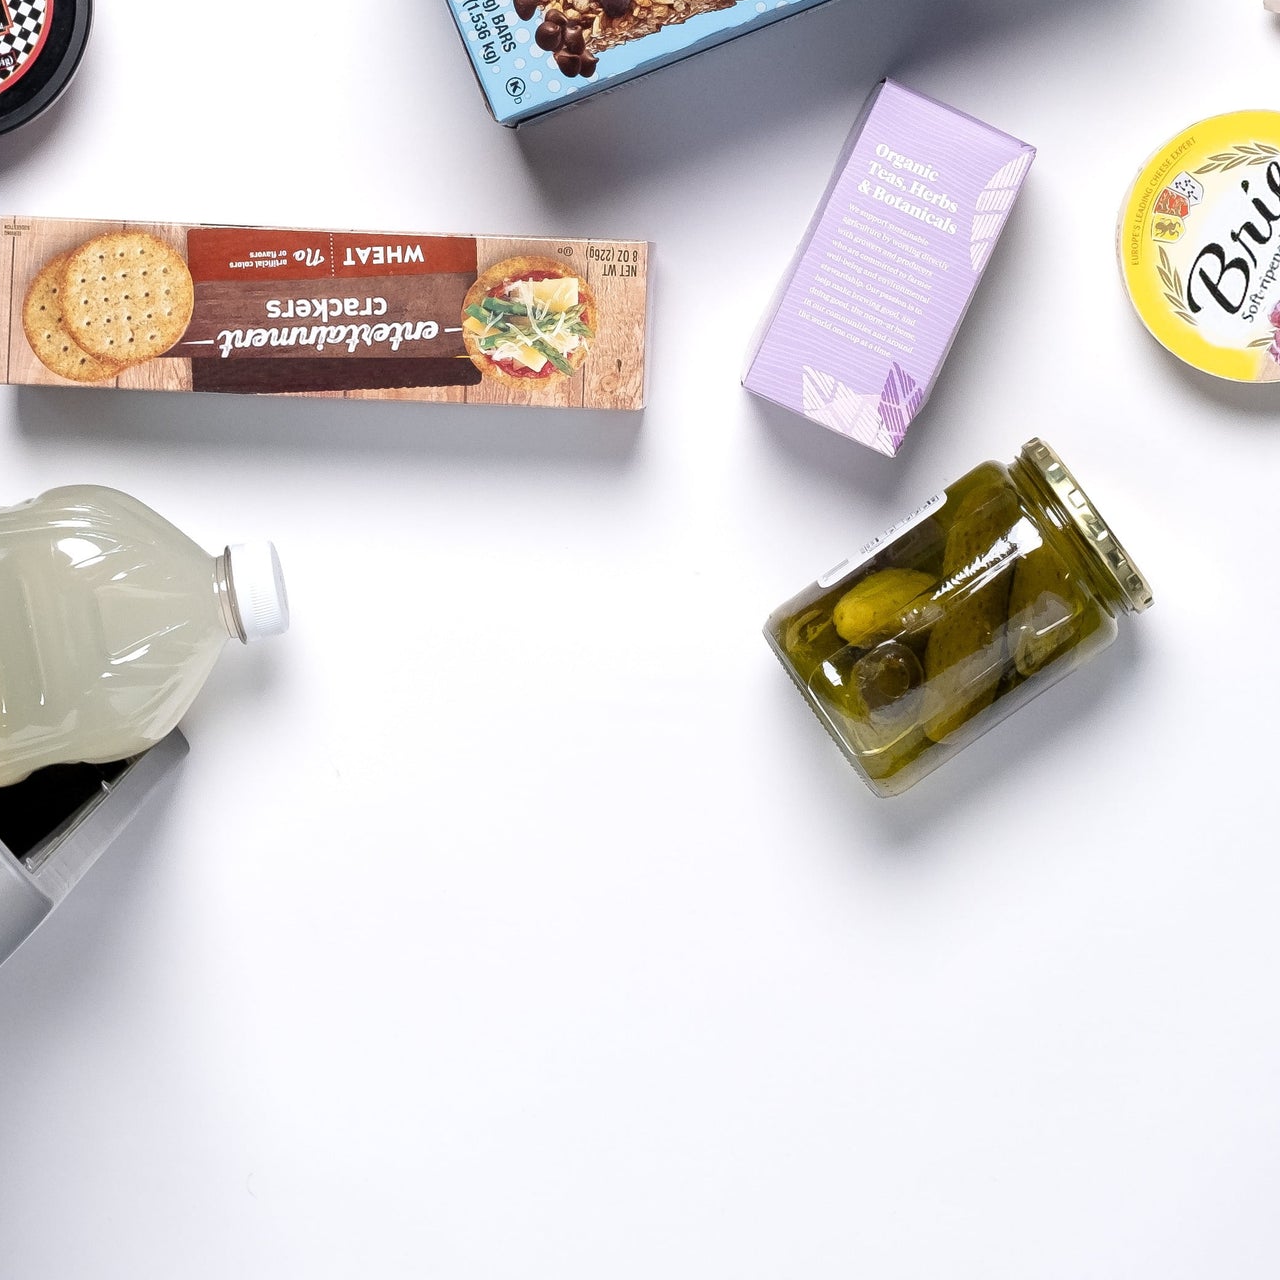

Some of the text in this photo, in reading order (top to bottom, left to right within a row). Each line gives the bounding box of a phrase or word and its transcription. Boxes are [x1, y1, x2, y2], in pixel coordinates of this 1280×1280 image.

[491, 13, 516, 52] BARS
[482, 41, 500, 64] kg)
[876, 144, 938, 180] Organic
[868, 160, 957, 212] Teas, Herbs
[857, 179, 956, 233] & Botanicals
[1131, 136, 1197, 266] EUROPE'S LEADING CHEESE EXPERT
[229, 258, 287, 268] artificial colors
[249, 250, 276, 258] flavors
[292, 247, 324, 266] No
[343, 245, 423, 265] WHEAT
[585, 245, 637, 262] 8 OZ (226g)
[601, 264, 637, 276] NET WT
[266, 297, 386, 321] crackers
[219, 314, 437, 356] entertainment
